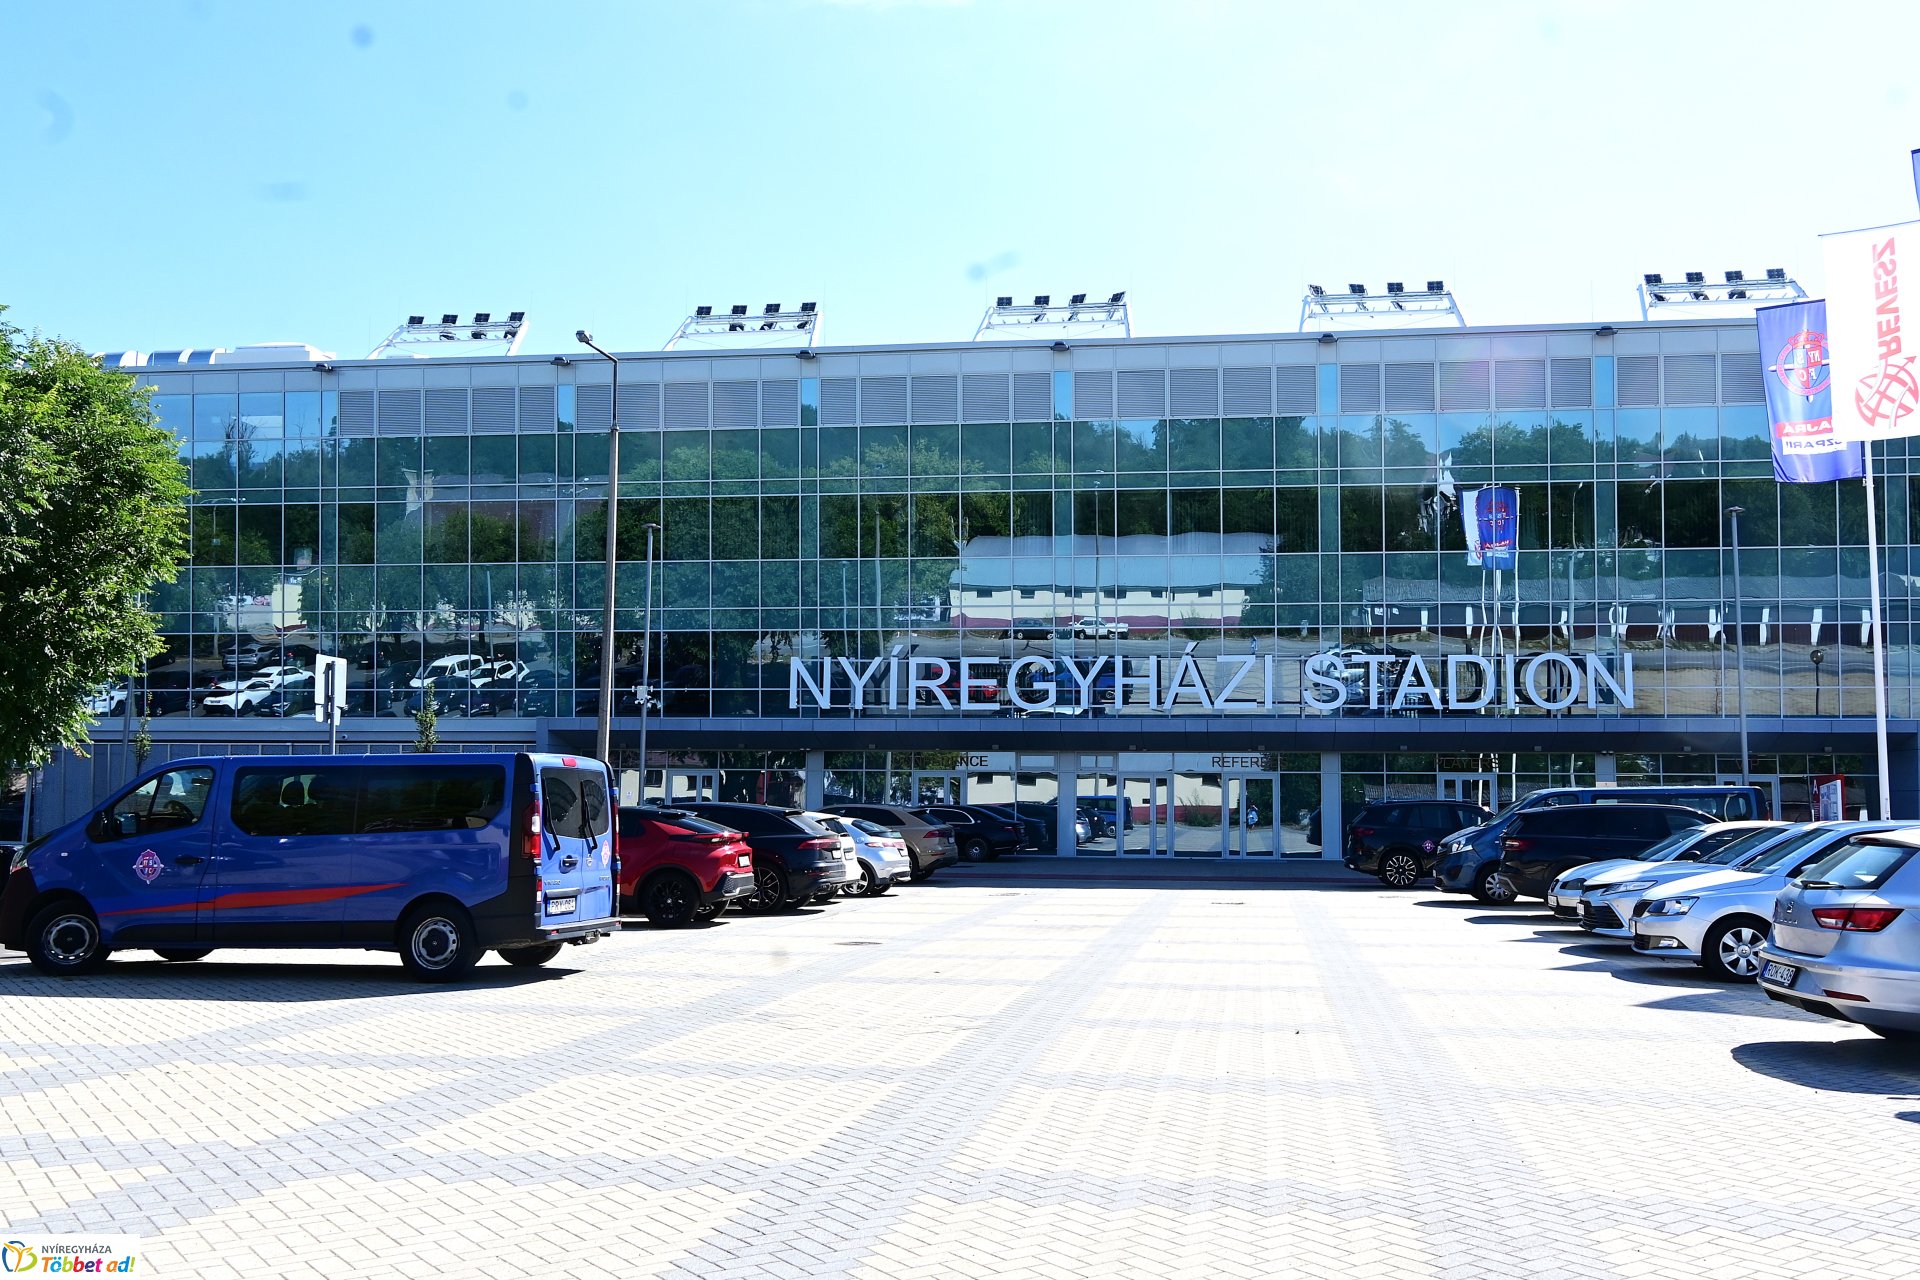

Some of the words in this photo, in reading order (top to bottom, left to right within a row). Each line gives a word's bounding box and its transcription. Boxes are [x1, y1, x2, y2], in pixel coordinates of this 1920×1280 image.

[789, 642, 1273, 710] NYÍREGYHÁZI
[1302, 653, 1634, 710] STADION
[1211, 756, 1287, 768] REFERE
[1735, 758, 1760, 770] VP
